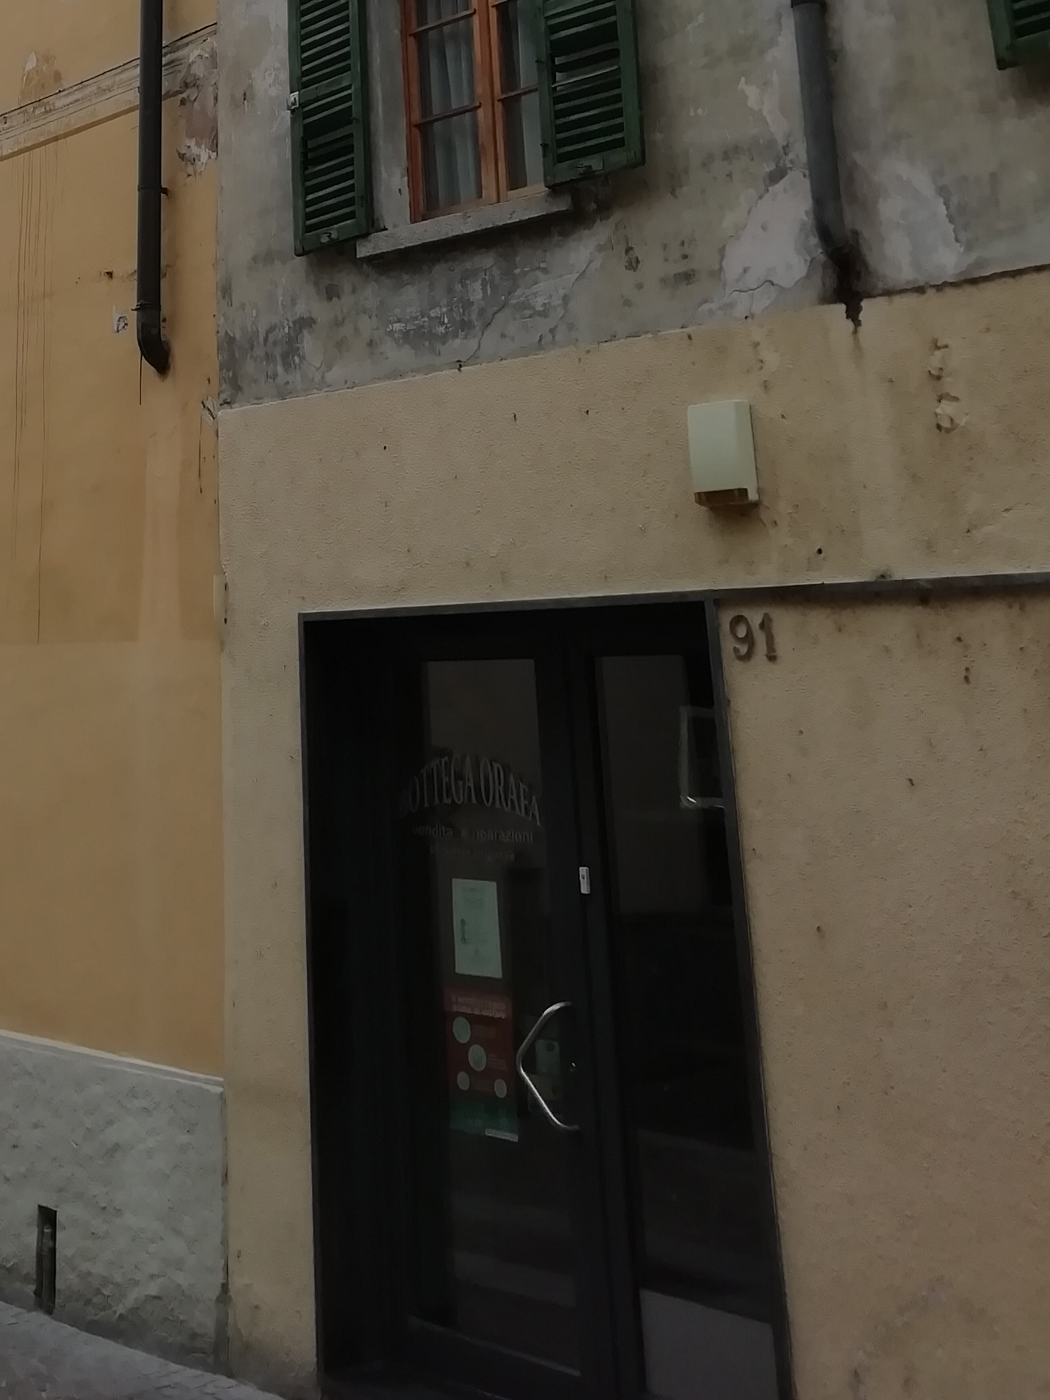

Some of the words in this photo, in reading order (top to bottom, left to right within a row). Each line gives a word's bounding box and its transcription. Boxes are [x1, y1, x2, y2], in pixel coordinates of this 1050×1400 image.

[729, 612, 778, 663] 91
[480, 756, 542, 828] ORAFA
[412, 823, 453, 838] vendita
